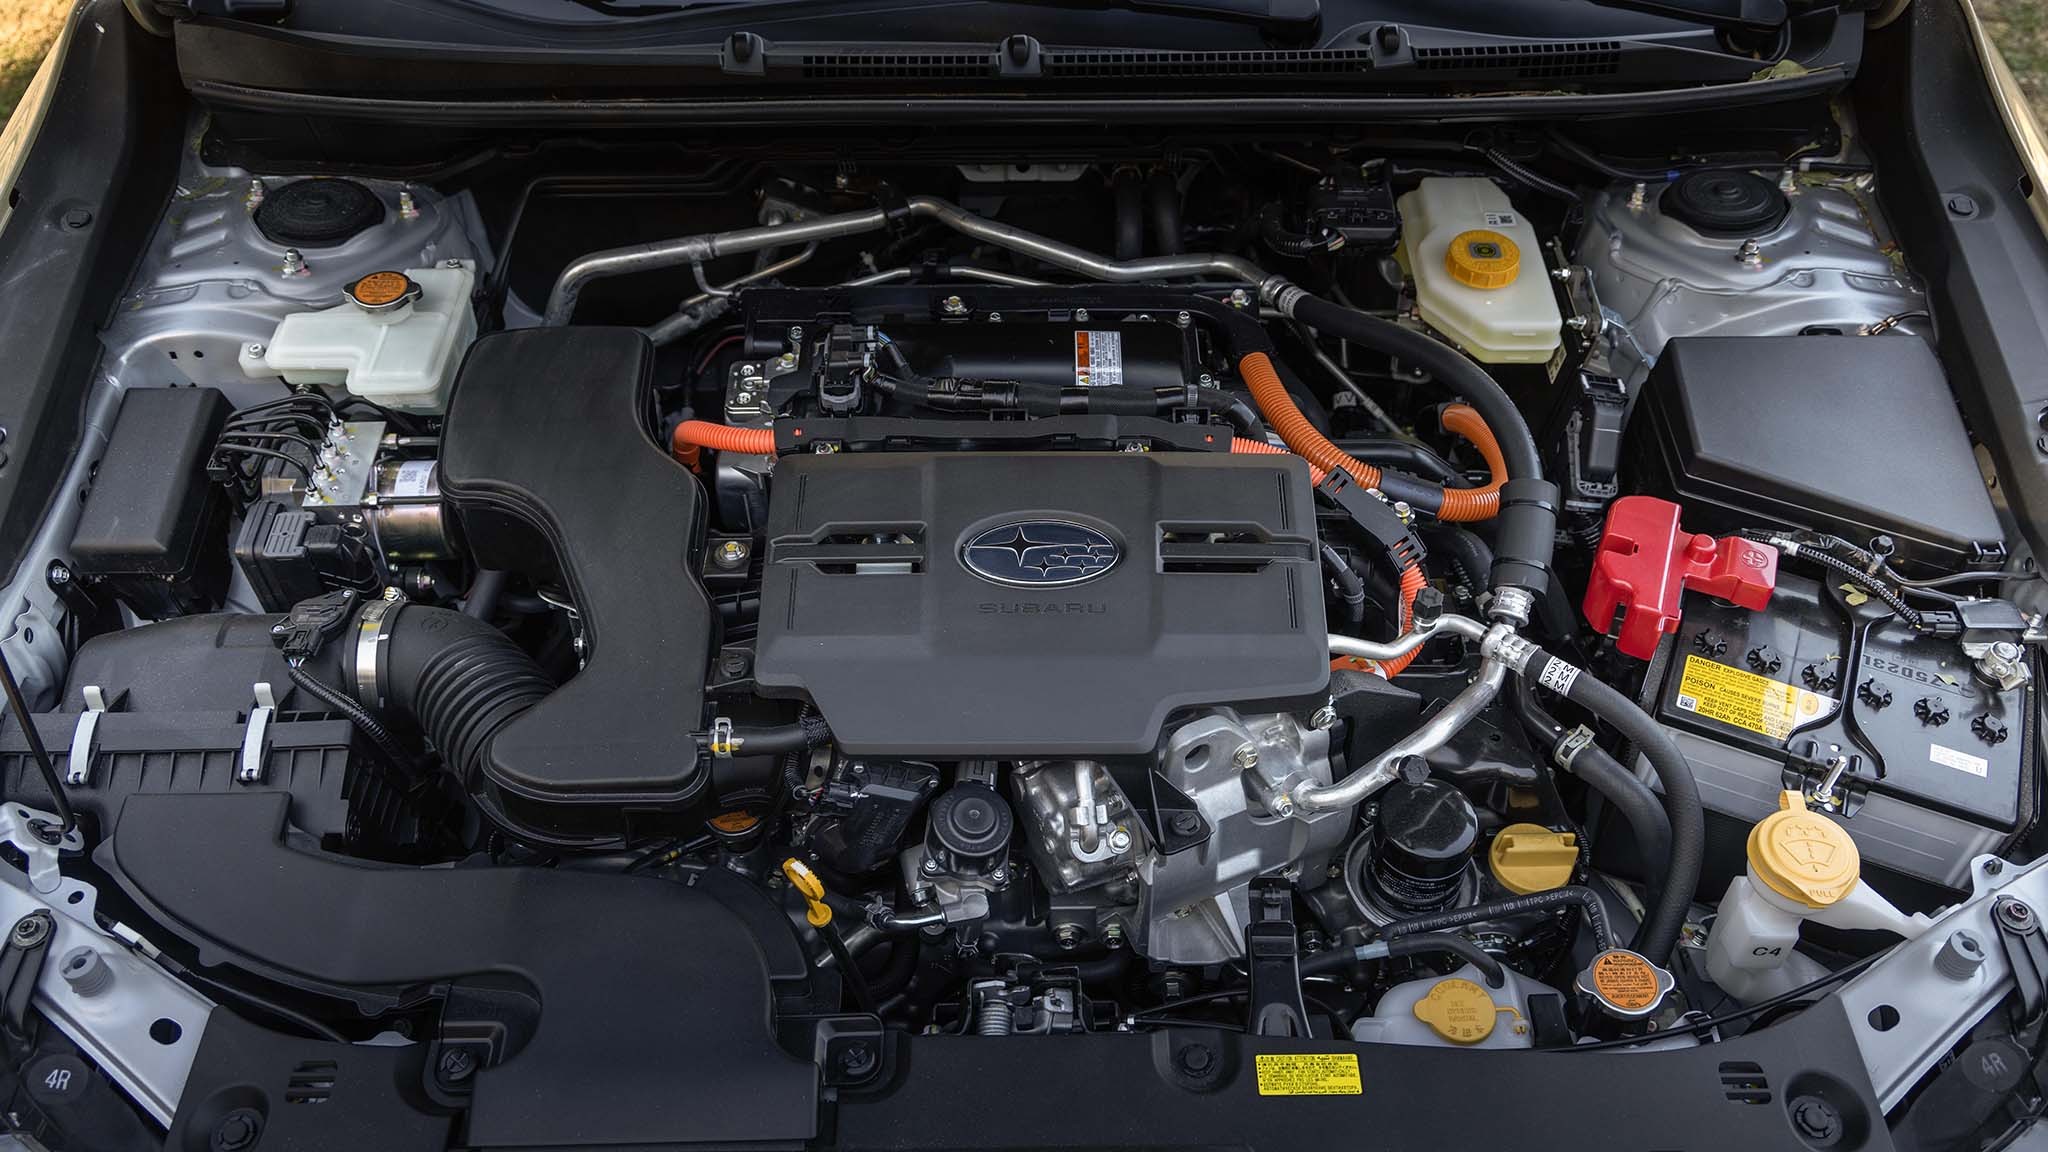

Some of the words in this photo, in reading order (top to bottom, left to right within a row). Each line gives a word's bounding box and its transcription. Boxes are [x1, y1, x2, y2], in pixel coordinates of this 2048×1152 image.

[976, 602, 1108, 615] SUBARU
[1689, 656, 1721, 670] DANGER
[1685, 675, 1715, 689] POISON
[1719, 687, 1740, 697] CAUSES
[1703, 701, 1716, 709] KEEP
[1732, 705, 1746, 713] CAPS
[1698, 706, 1714, 715] 20HR
[1715, 712, 1731, 721] 62Ah
[1733, 717, 1747, 726] CCA
[1748, 722, 1763, 731] 470A
[1752, 946, 1782, 958] C4
[1981, 1052, 2008, 1077] 4R
[45, 1069, 71, 1090] 4R
